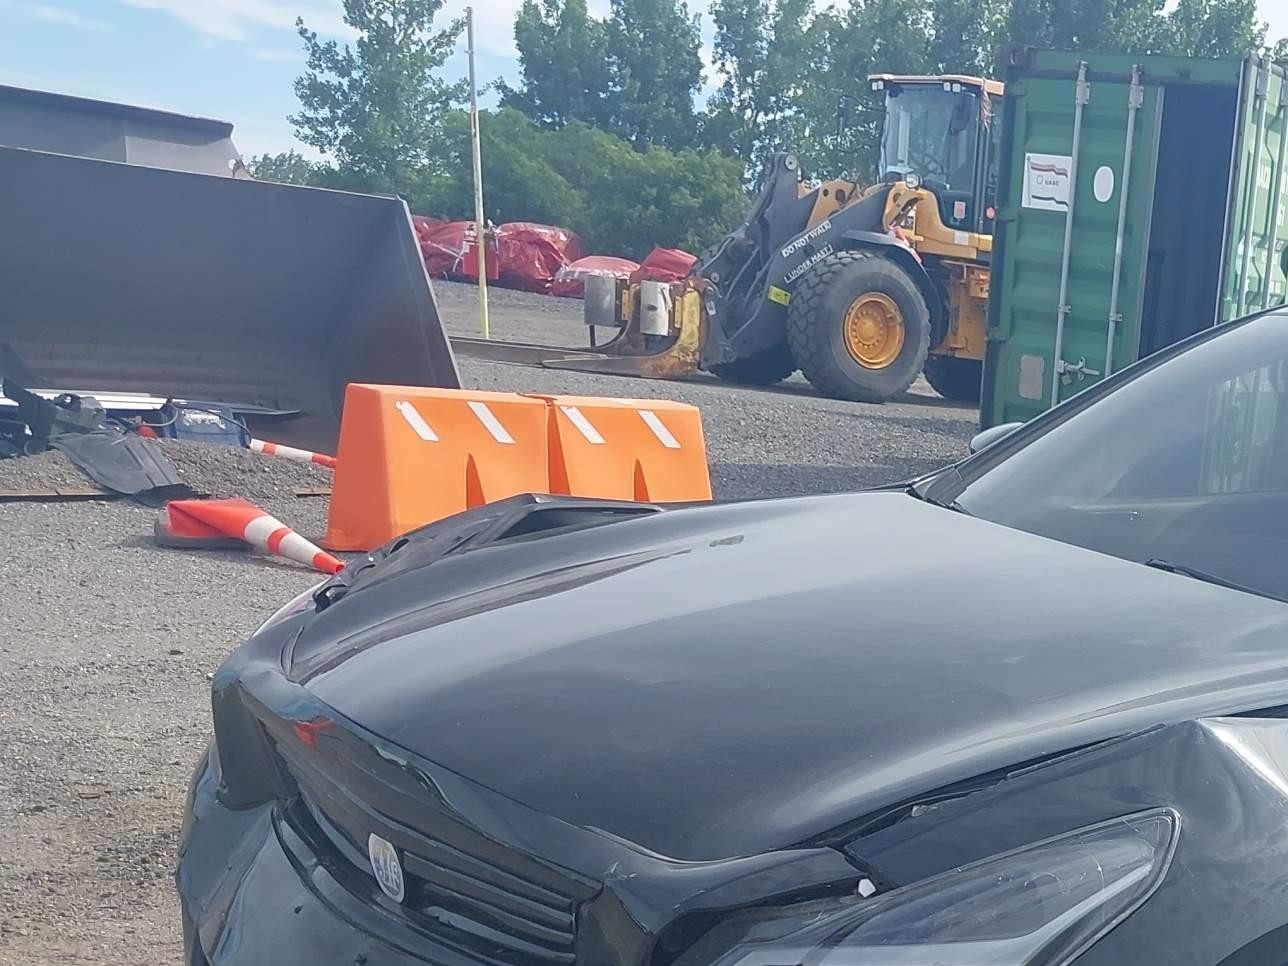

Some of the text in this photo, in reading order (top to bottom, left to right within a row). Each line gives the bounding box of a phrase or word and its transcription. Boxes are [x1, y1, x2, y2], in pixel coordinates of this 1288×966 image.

[781, 246, 794, 258] DO
[794, 236, 811, 250] NOT
[788, 246, 829, 279] UNDER MAST
